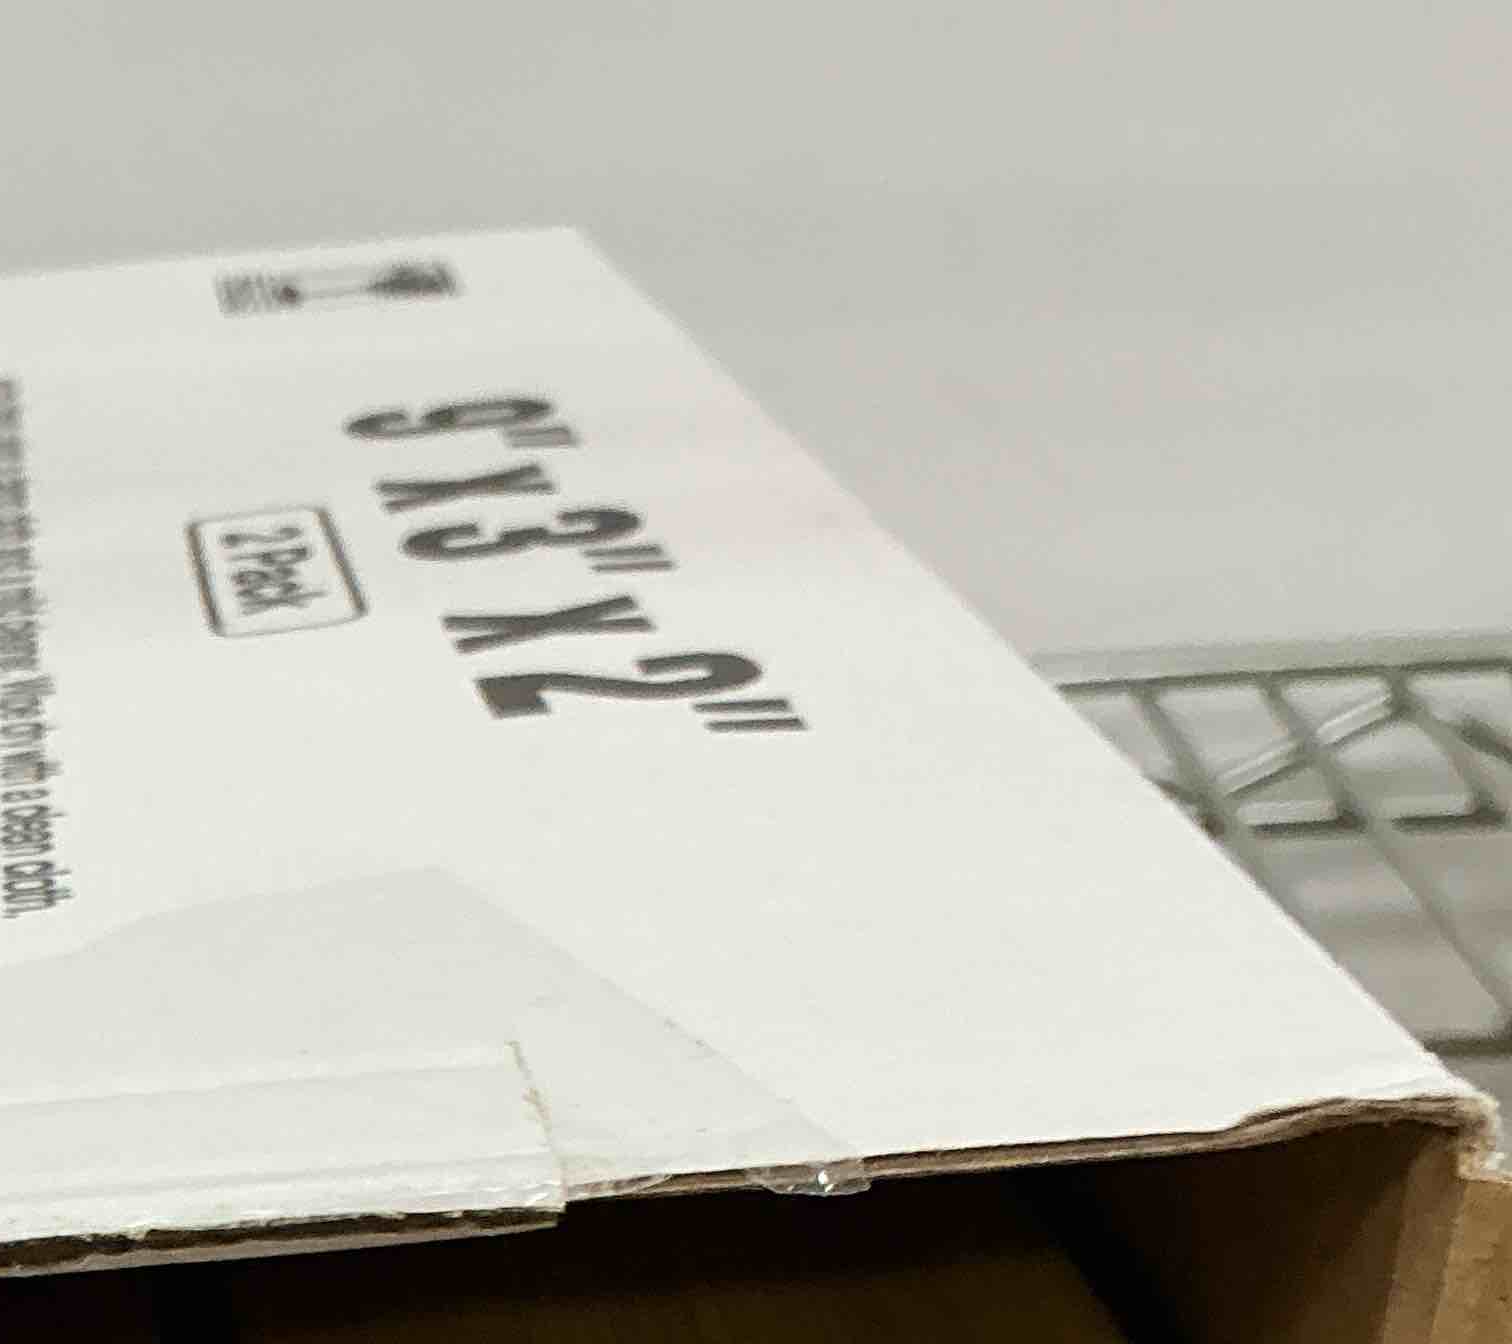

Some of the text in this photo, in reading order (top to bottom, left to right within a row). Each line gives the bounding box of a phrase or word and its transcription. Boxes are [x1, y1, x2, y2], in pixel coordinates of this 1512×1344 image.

[345, 397, 580, 449] 9"
[400, 506, 676, 571] 3"
[219, 525, 330, 617] 2 Pack
[474, 651, 807, 733] 2"
[0, 750, 64, 787] with
[0, 788, 51, 803] a
[0, 803, 68, 859] clean
[2, 859, 75, 919] cloth.
